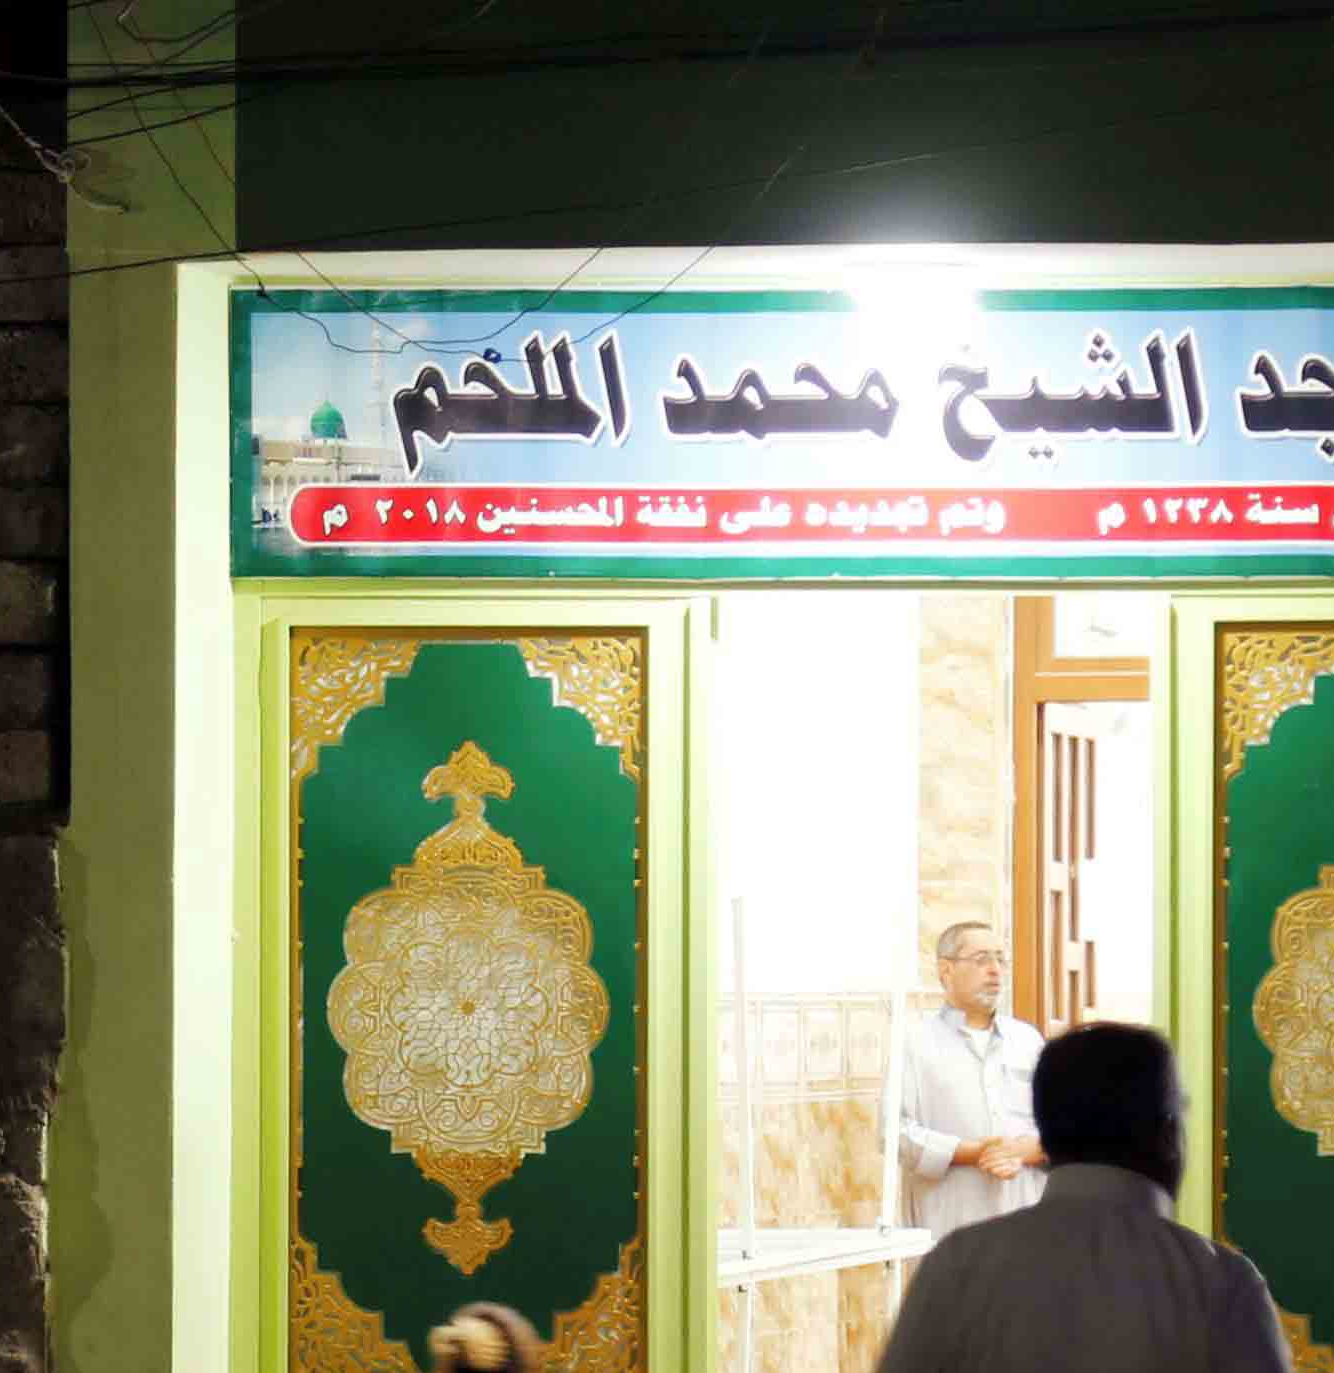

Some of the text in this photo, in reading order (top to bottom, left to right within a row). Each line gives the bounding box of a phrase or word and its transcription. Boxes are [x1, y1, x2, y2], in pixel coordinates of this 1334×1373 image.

[661, 357, 900, 440] محمد
[937, 331, 1205, 462] الشيخ
[322, 504, 349, 536] م
[375, 498, 466, 524] ٢٠١٨
[476, 495, 624, 534] المحسنين
[635, 495, 708, 528] نفقة
[719, 496, 793, 535] على
[803, 496, 929, 534] تجديده
[939, 498, 1006, 536] وتم
[1097, 502, 1127, 536] م
[1245, 493, 1320, 524] سنة
